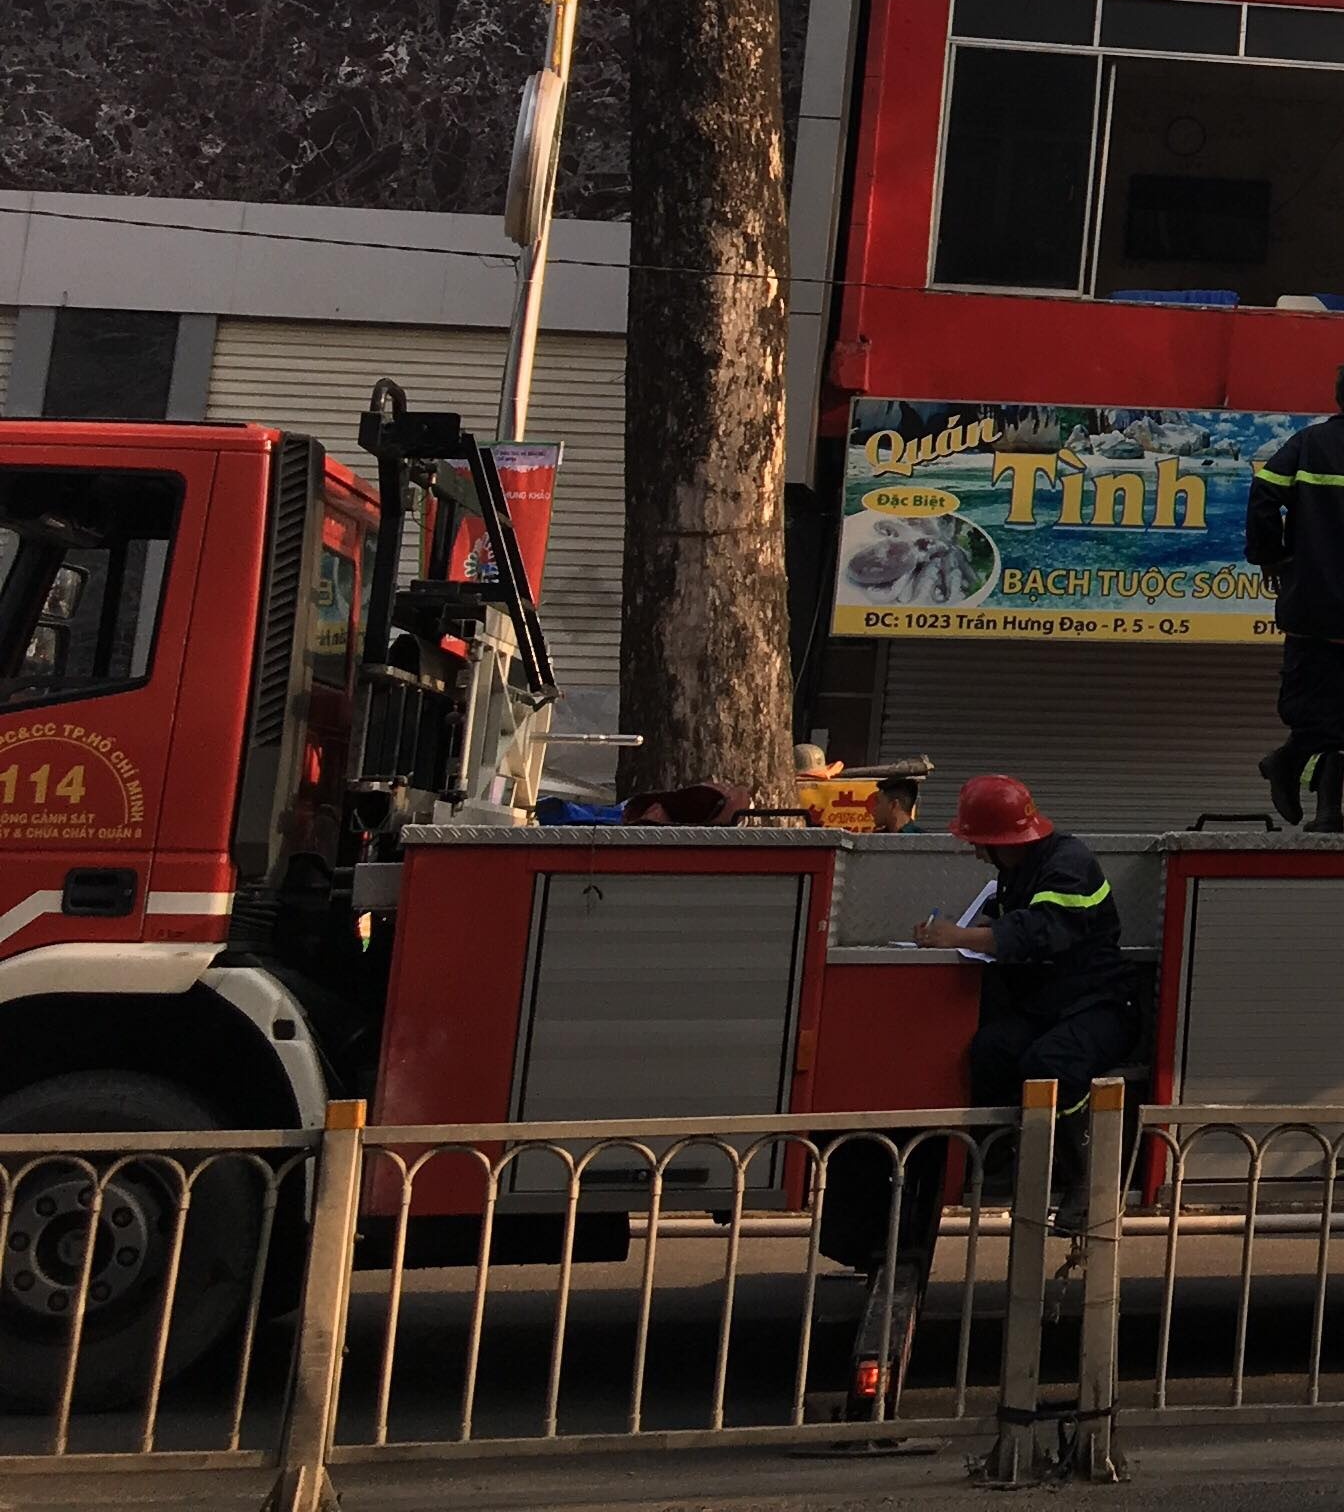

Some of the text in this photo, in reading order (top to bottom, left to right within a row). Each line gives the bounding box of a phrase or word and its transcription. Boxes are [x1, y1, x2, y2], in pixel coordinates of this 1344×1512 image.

[863, 414, 1003, 478] Quán
[877, 493, 946, 510] Đặc Biệt
[990, 448, 1209, 532] Tình
[1002, 567, 1090, 603] BẠCH
[1097, 564, 1187, 606] TUỘC
[864, 611, 900, 629] ĐC:
[904, 613, 951, 630] 1023
[955, 611, 998, 632] Trần
[1002, 615, 1055, 635] Hưng
[1058, 616, 1098, 637] Đạo
[1158, 618, 1191, 635] Q.5
[0, 763, 87, 804] 114
